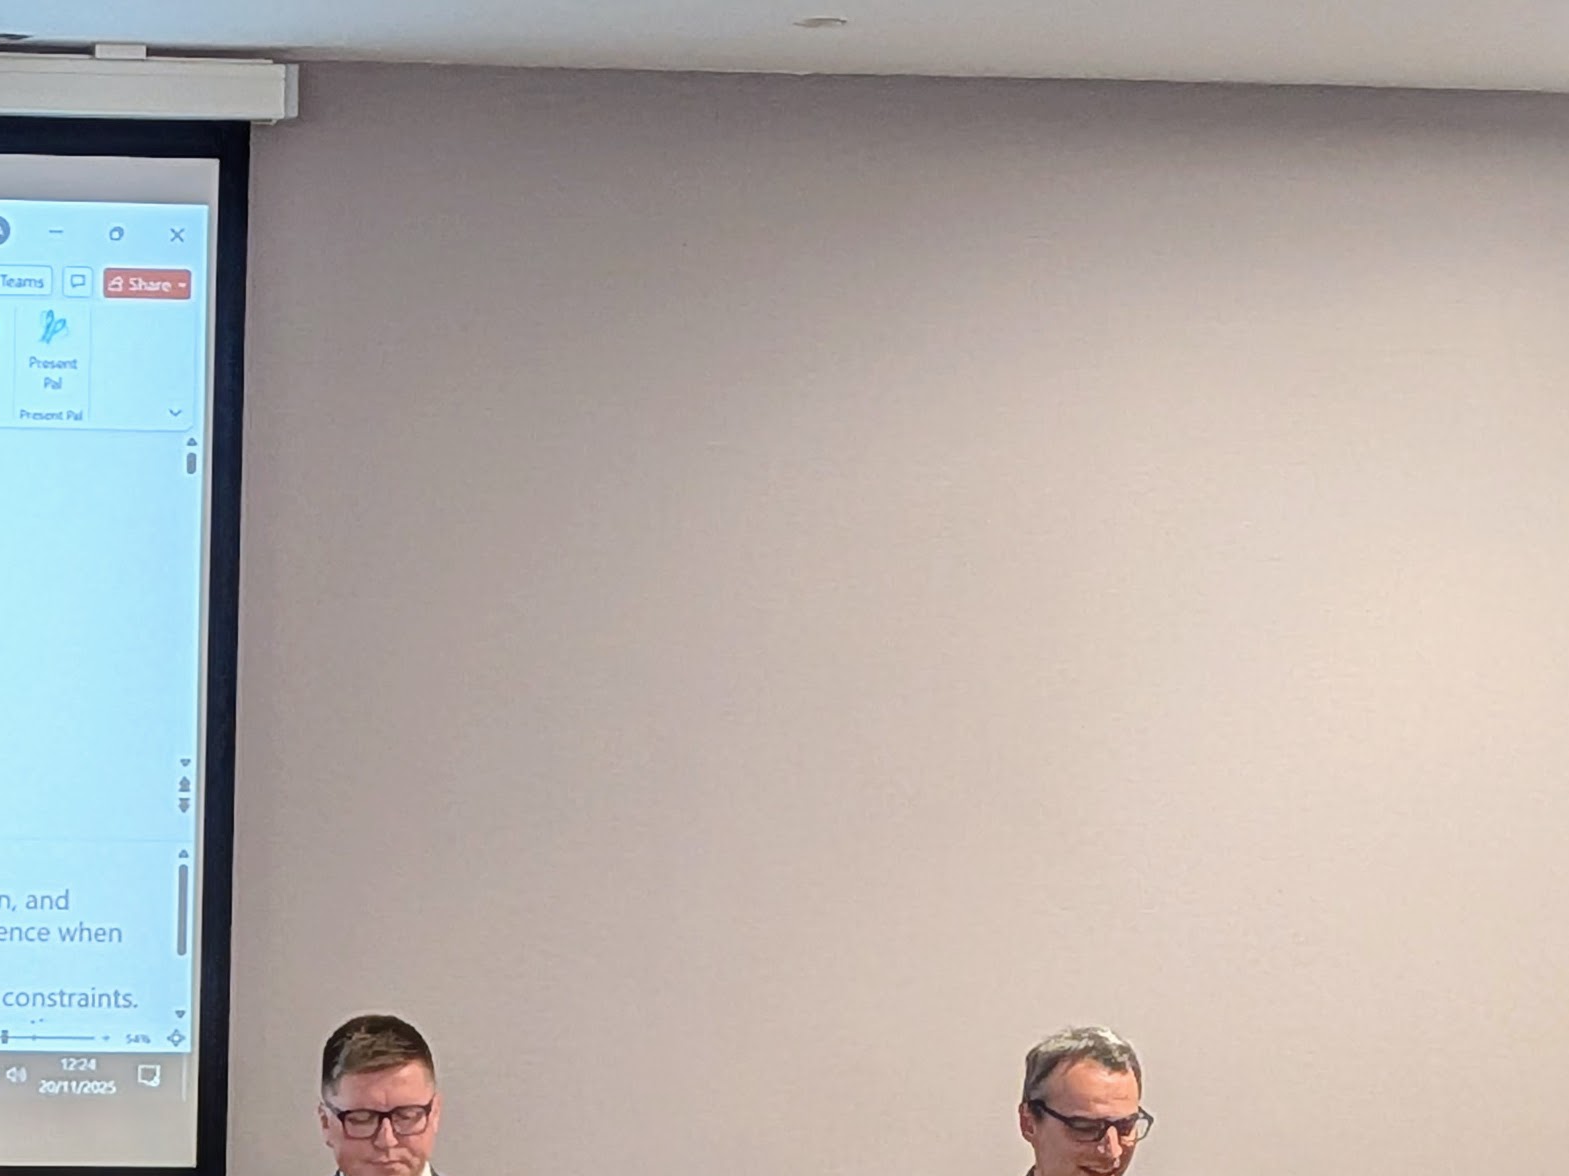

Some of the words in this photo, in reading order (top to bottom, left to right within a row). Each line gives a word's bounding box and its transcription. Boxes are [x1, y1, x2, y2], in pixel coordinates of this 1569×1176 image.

[0, 274, 44, 289] Teams
[129, 277, 171, 292] Share
[29, 356, 78, 371] Present
[44, 377, 63, 390] Pal
[26, 889, 69, 911] and
[58, 923, 123, 944] when
[2, 987, 139, 1009] constraints.
[61, 1058, 96, 1071] 12:24
[39, 1079, 116, 1094] 20/11/2025
